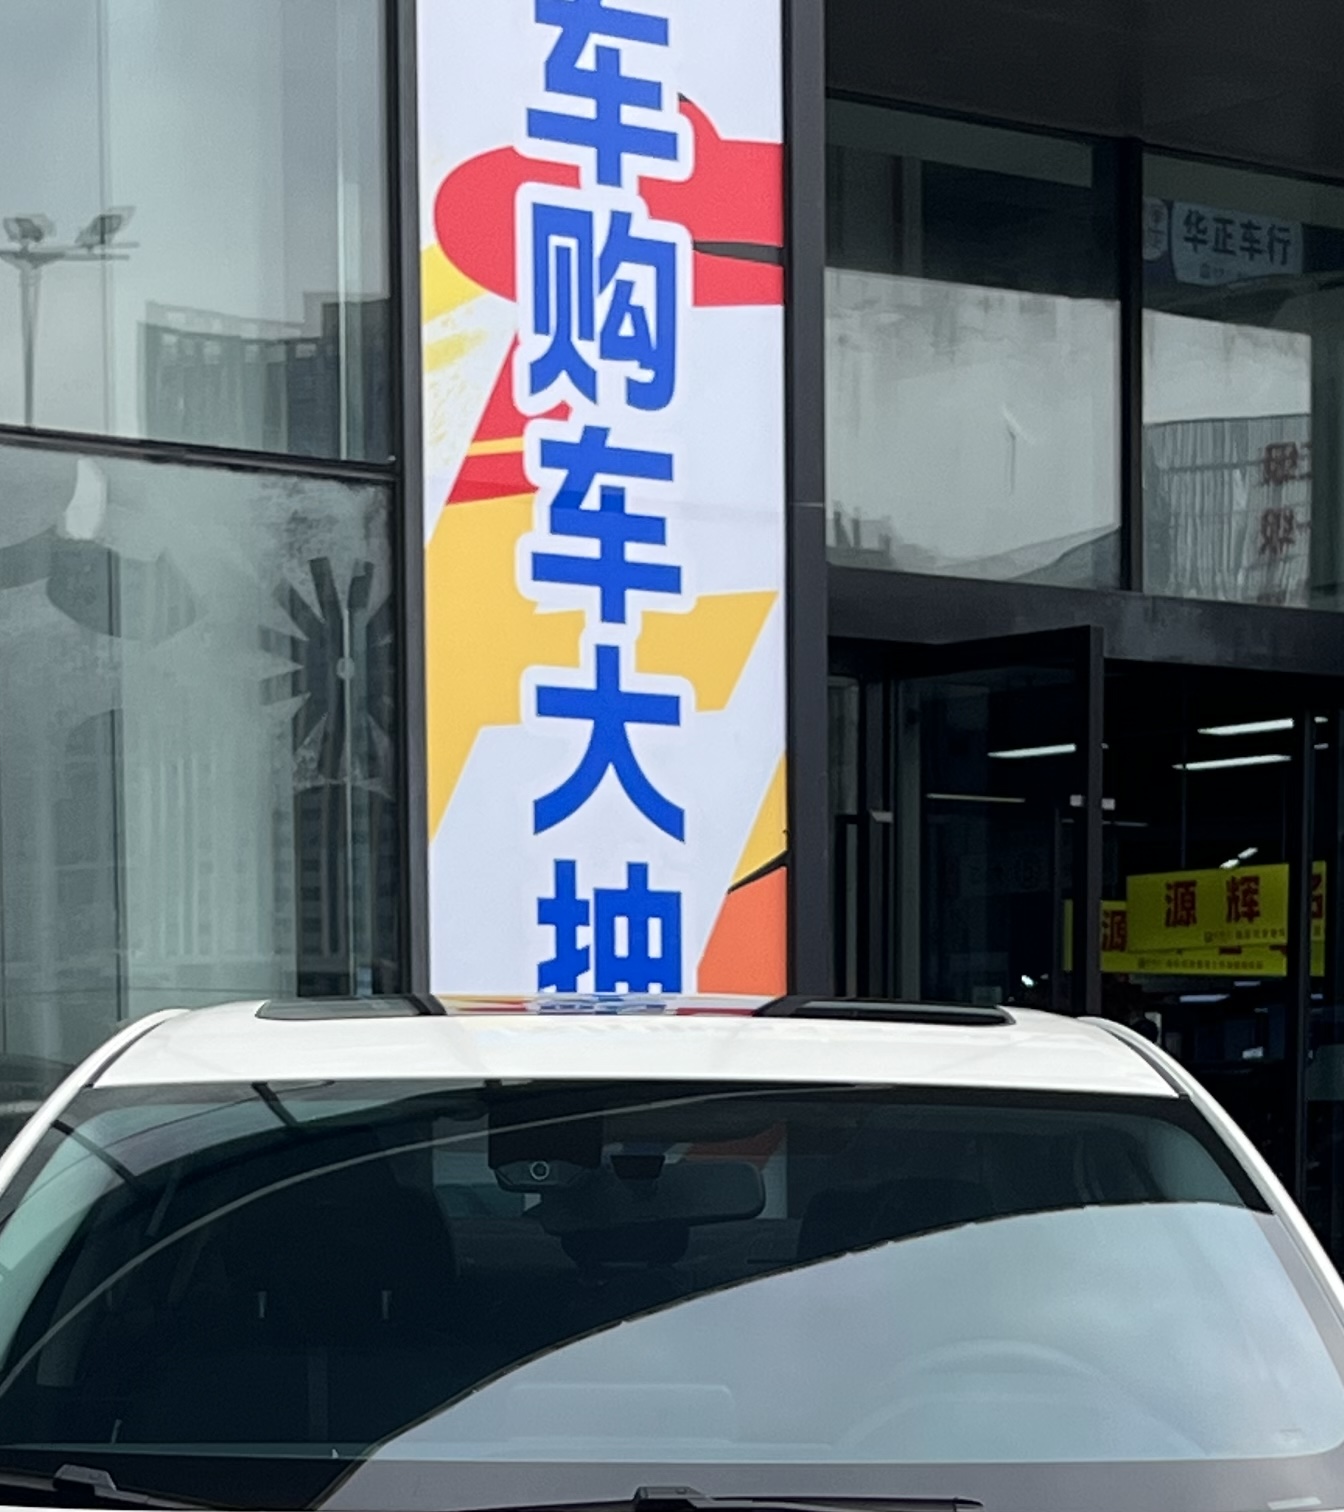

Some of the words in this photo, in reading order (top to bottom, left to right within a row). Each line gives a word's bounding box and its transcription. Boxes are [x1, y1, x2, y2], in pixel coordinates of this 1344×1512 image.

[526, 0, 686, 994] 车购车大抽
[1182, 209, 1292, 266] 华正车行
